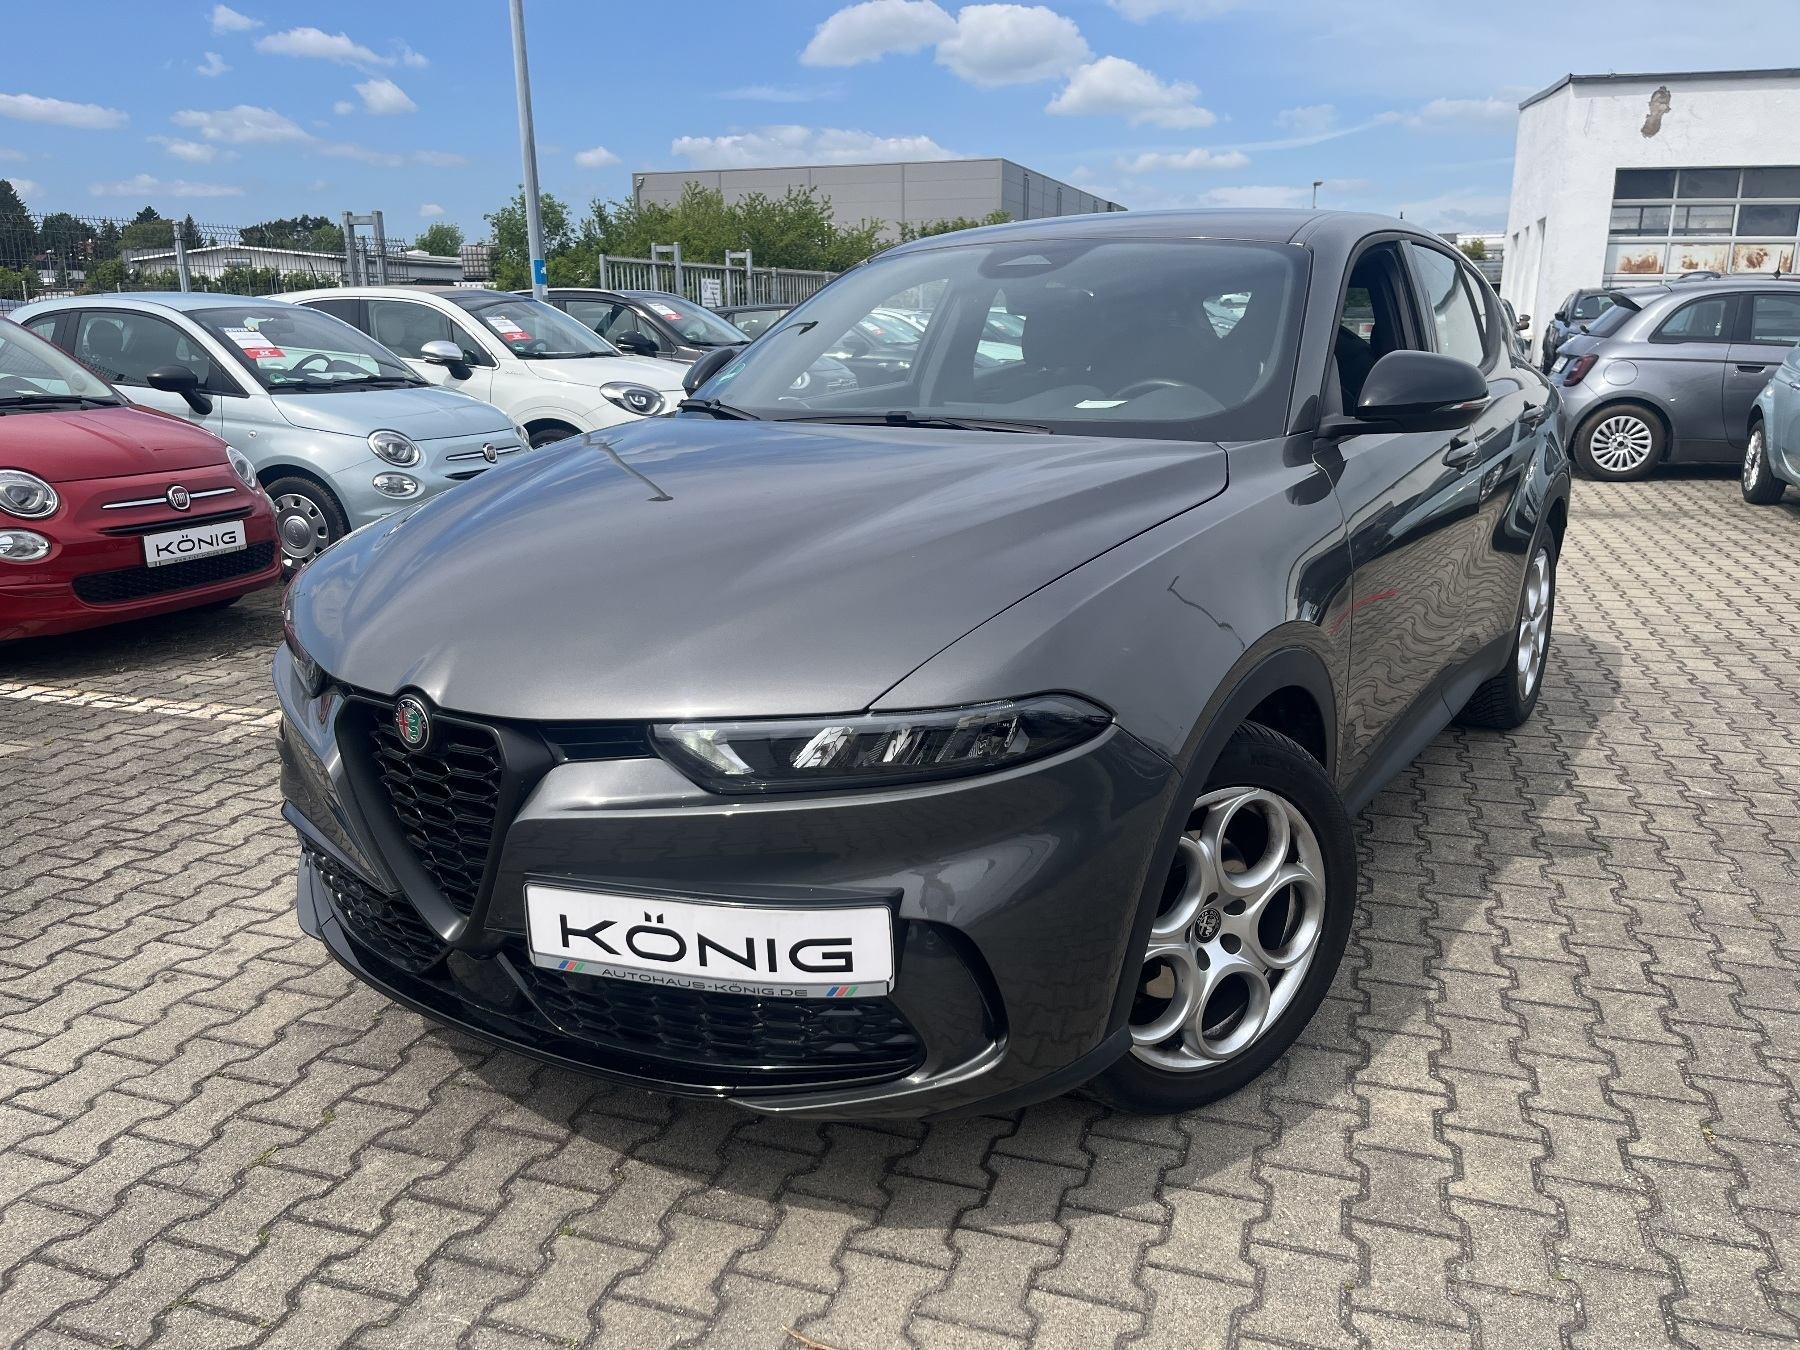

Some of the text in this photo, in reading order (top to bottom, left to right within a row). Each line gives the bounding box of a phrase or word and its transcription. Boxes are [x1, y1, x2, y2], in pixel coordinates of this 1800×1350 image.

[156, 531, 236, 557] KÖNIG
[559, 911, 853, 973] KÖNIG
[602, 968, 808, 997] AUTOHAUS-KÖNIG.DE
